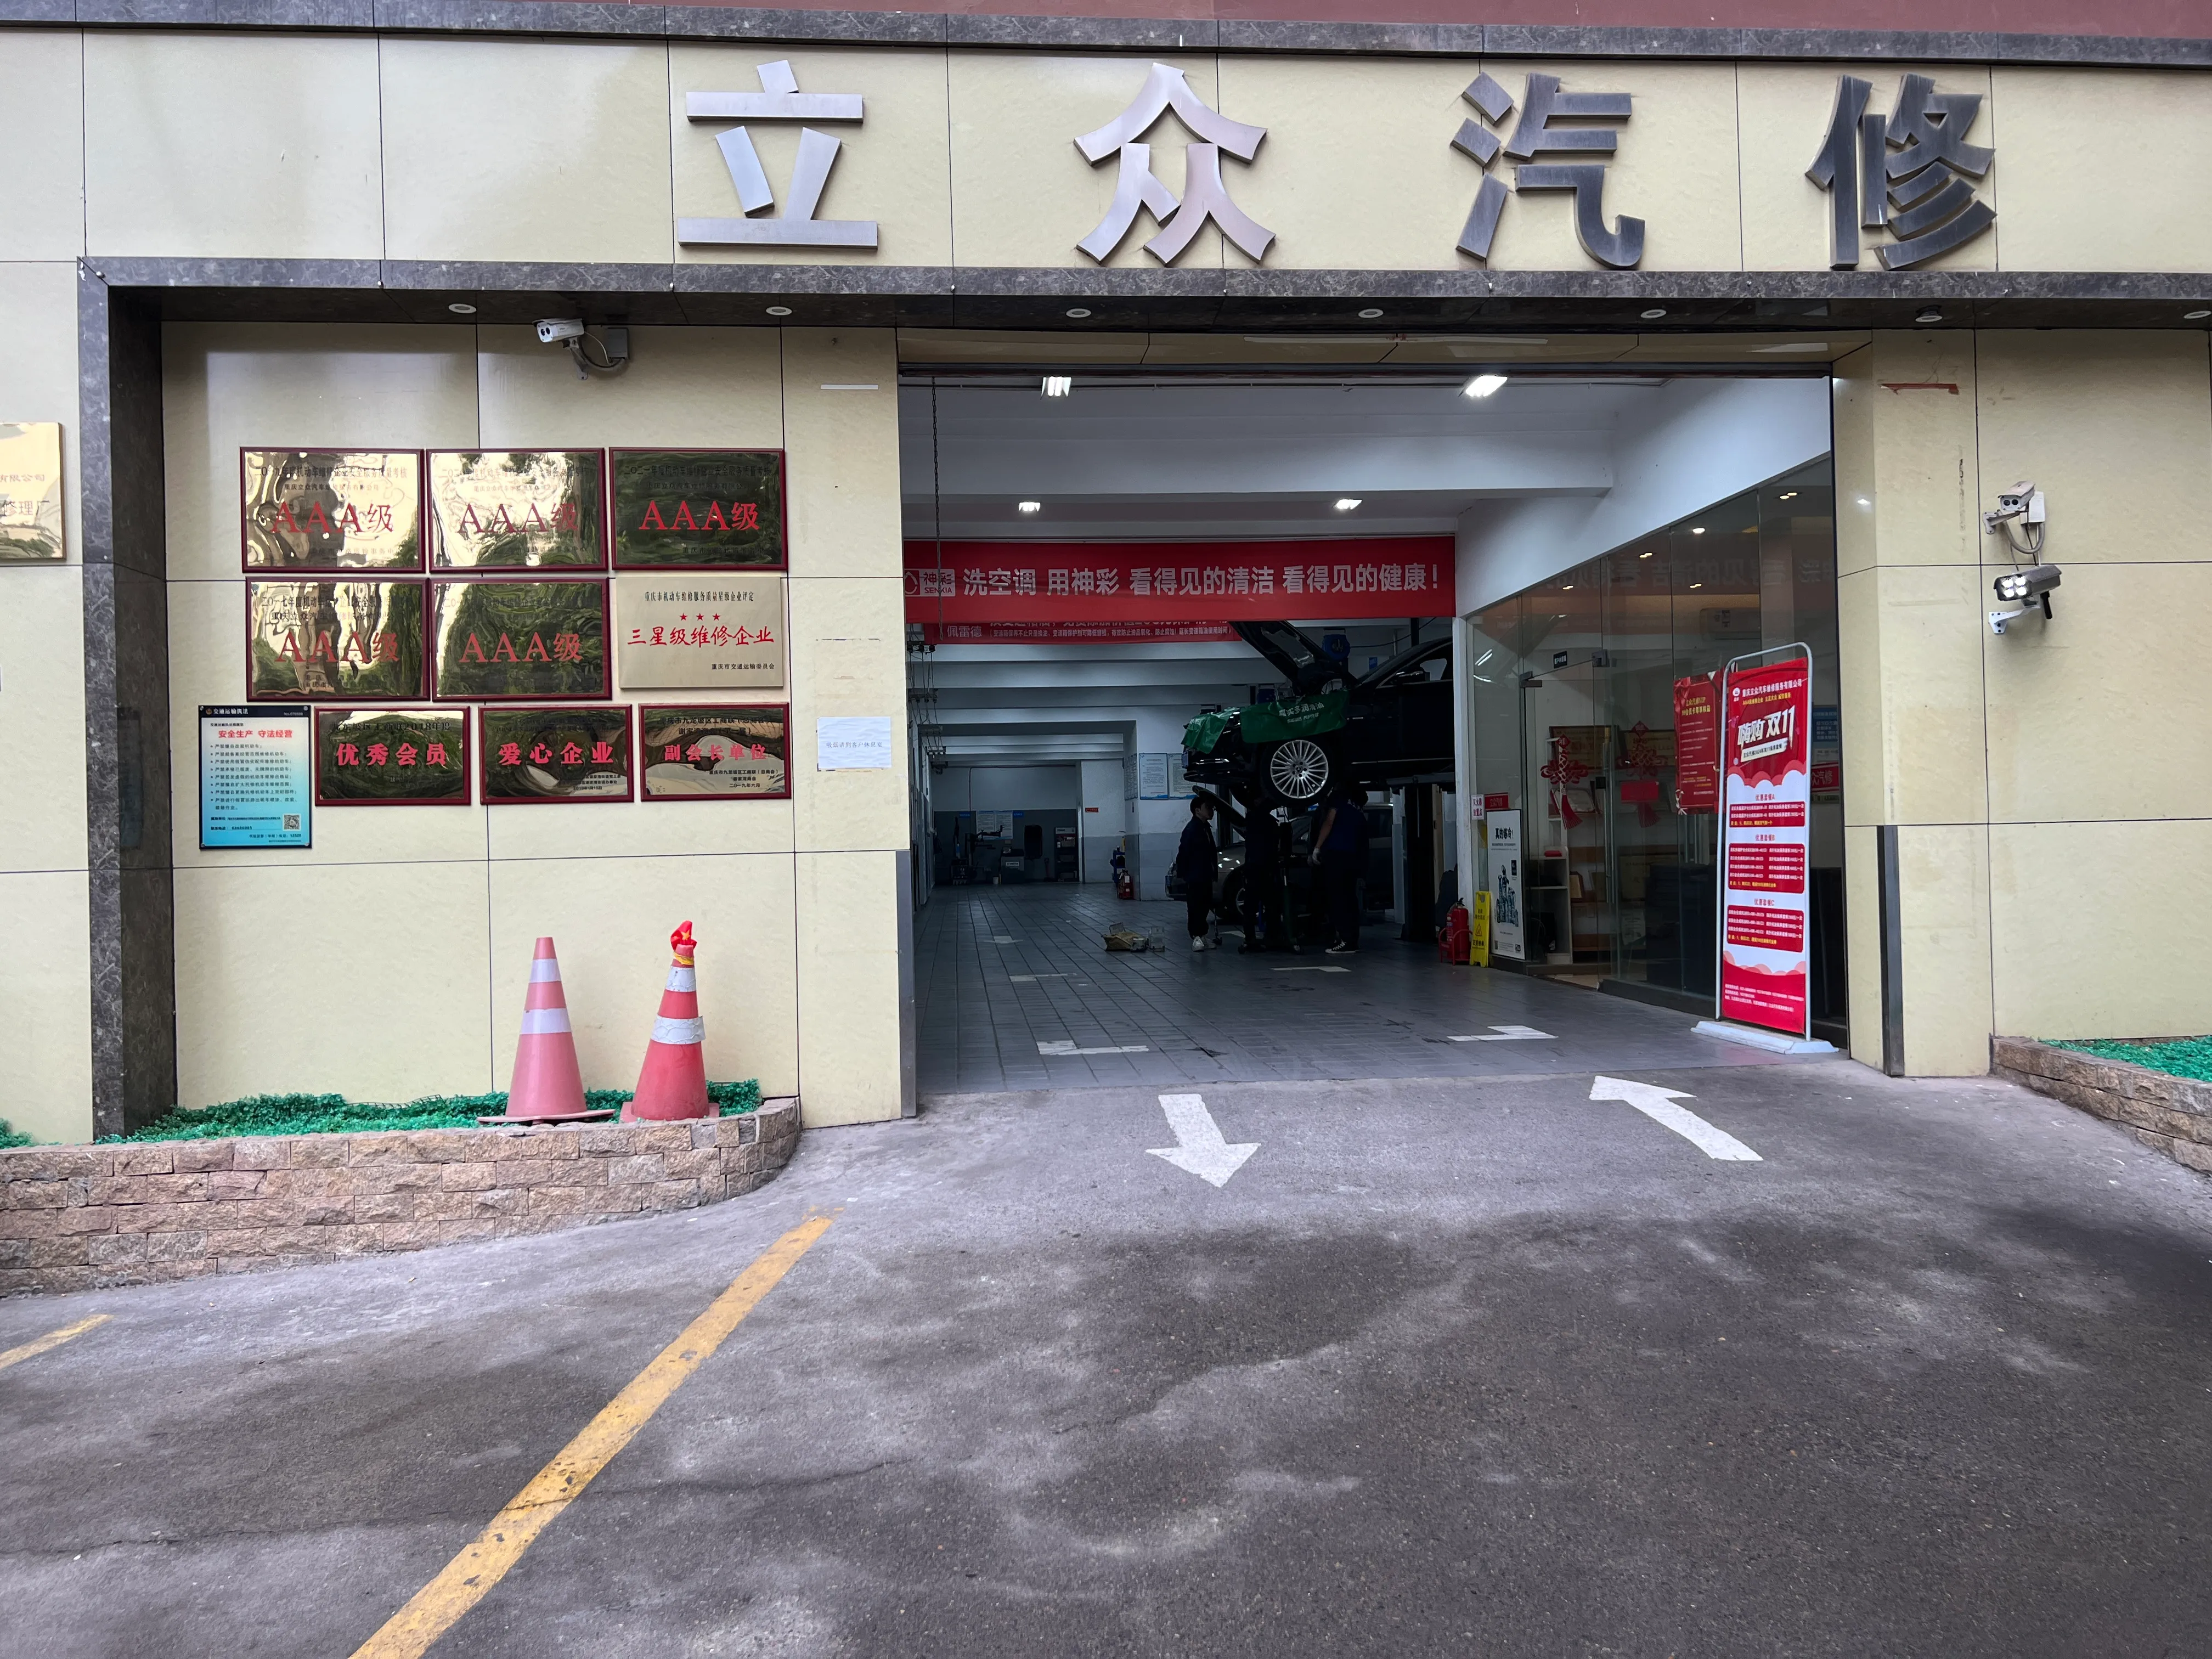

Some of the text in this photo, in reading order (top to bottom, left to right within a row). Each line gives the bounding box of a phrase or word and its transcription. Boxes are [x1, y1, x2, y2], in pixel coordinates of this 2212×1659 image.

[678, 59, 1997, 271] 立众汽修
[270, 500, 395, 533] AAA级
[456, 503, 578, 533] AAA级
[639, 500, 760, 531] AAA级
[962, 567, 1036, 597] 洗空调
[1047, 567, 1119, 597] 用神彩
[1129, 566, 1274, 596] 看得见的清洁
[645, 591, 754, 601] 重庆市机动车维修服务质量星级企业评定
[627, 625, 775, 648] 三星级维修企业
[947, 625, 982, 637] 佩雷德
[275, 630, 400, 663] AAA级
[459, 632, 583, 663] AAA级
[218, 730, 293, 738] 安全生产 守法经营
[336, 742, 447, 766] 优秀会员
[498, 741, 613, 766] 爱心企业
[664, 743, 766, 761] 副会长单位
